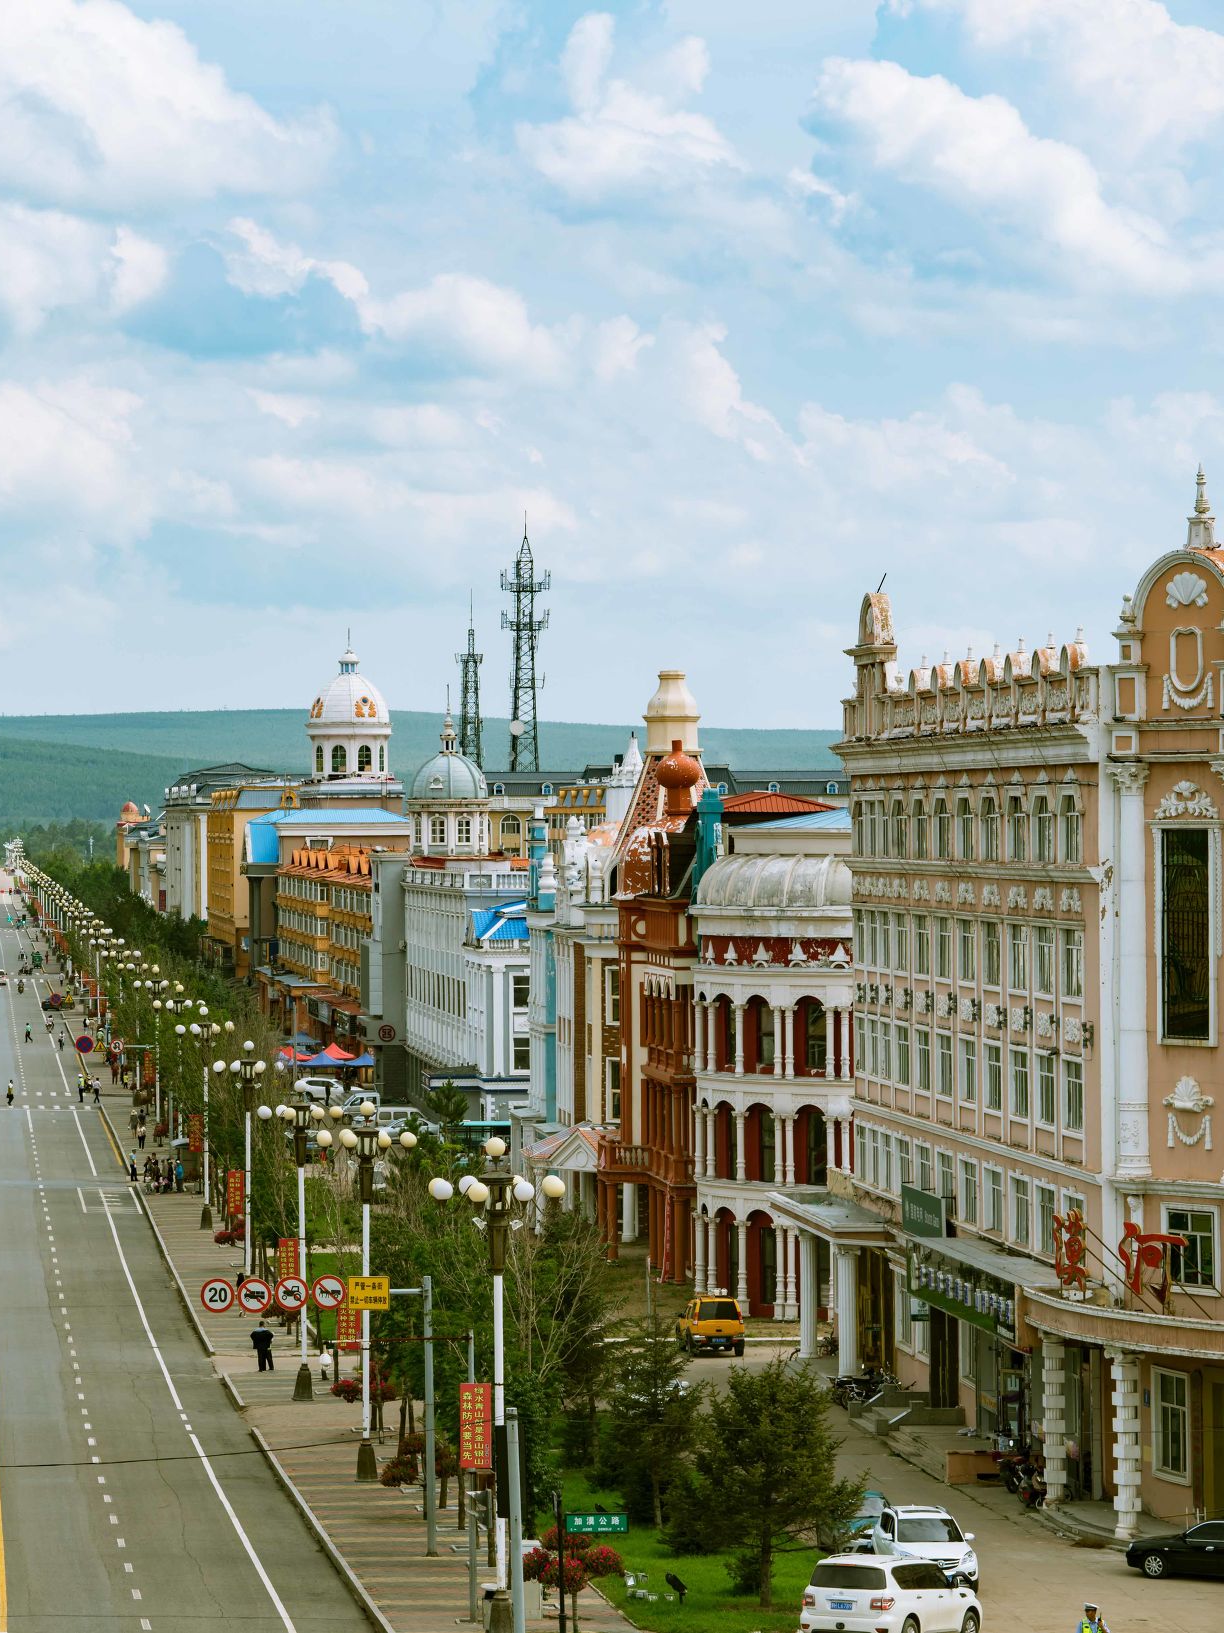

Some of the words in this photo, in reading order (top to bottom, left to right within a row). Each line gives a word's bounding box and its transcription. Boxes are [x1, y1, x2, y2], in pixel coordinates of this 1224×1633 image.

[1052, 1207, 1189, 1305] 漠河
[208, 1287, 228, 1303] 20
[462, 1391, 473, 1460] 森林防火要当先
[474, 1387, 484, 1465] 绿水青山就是金山银山
